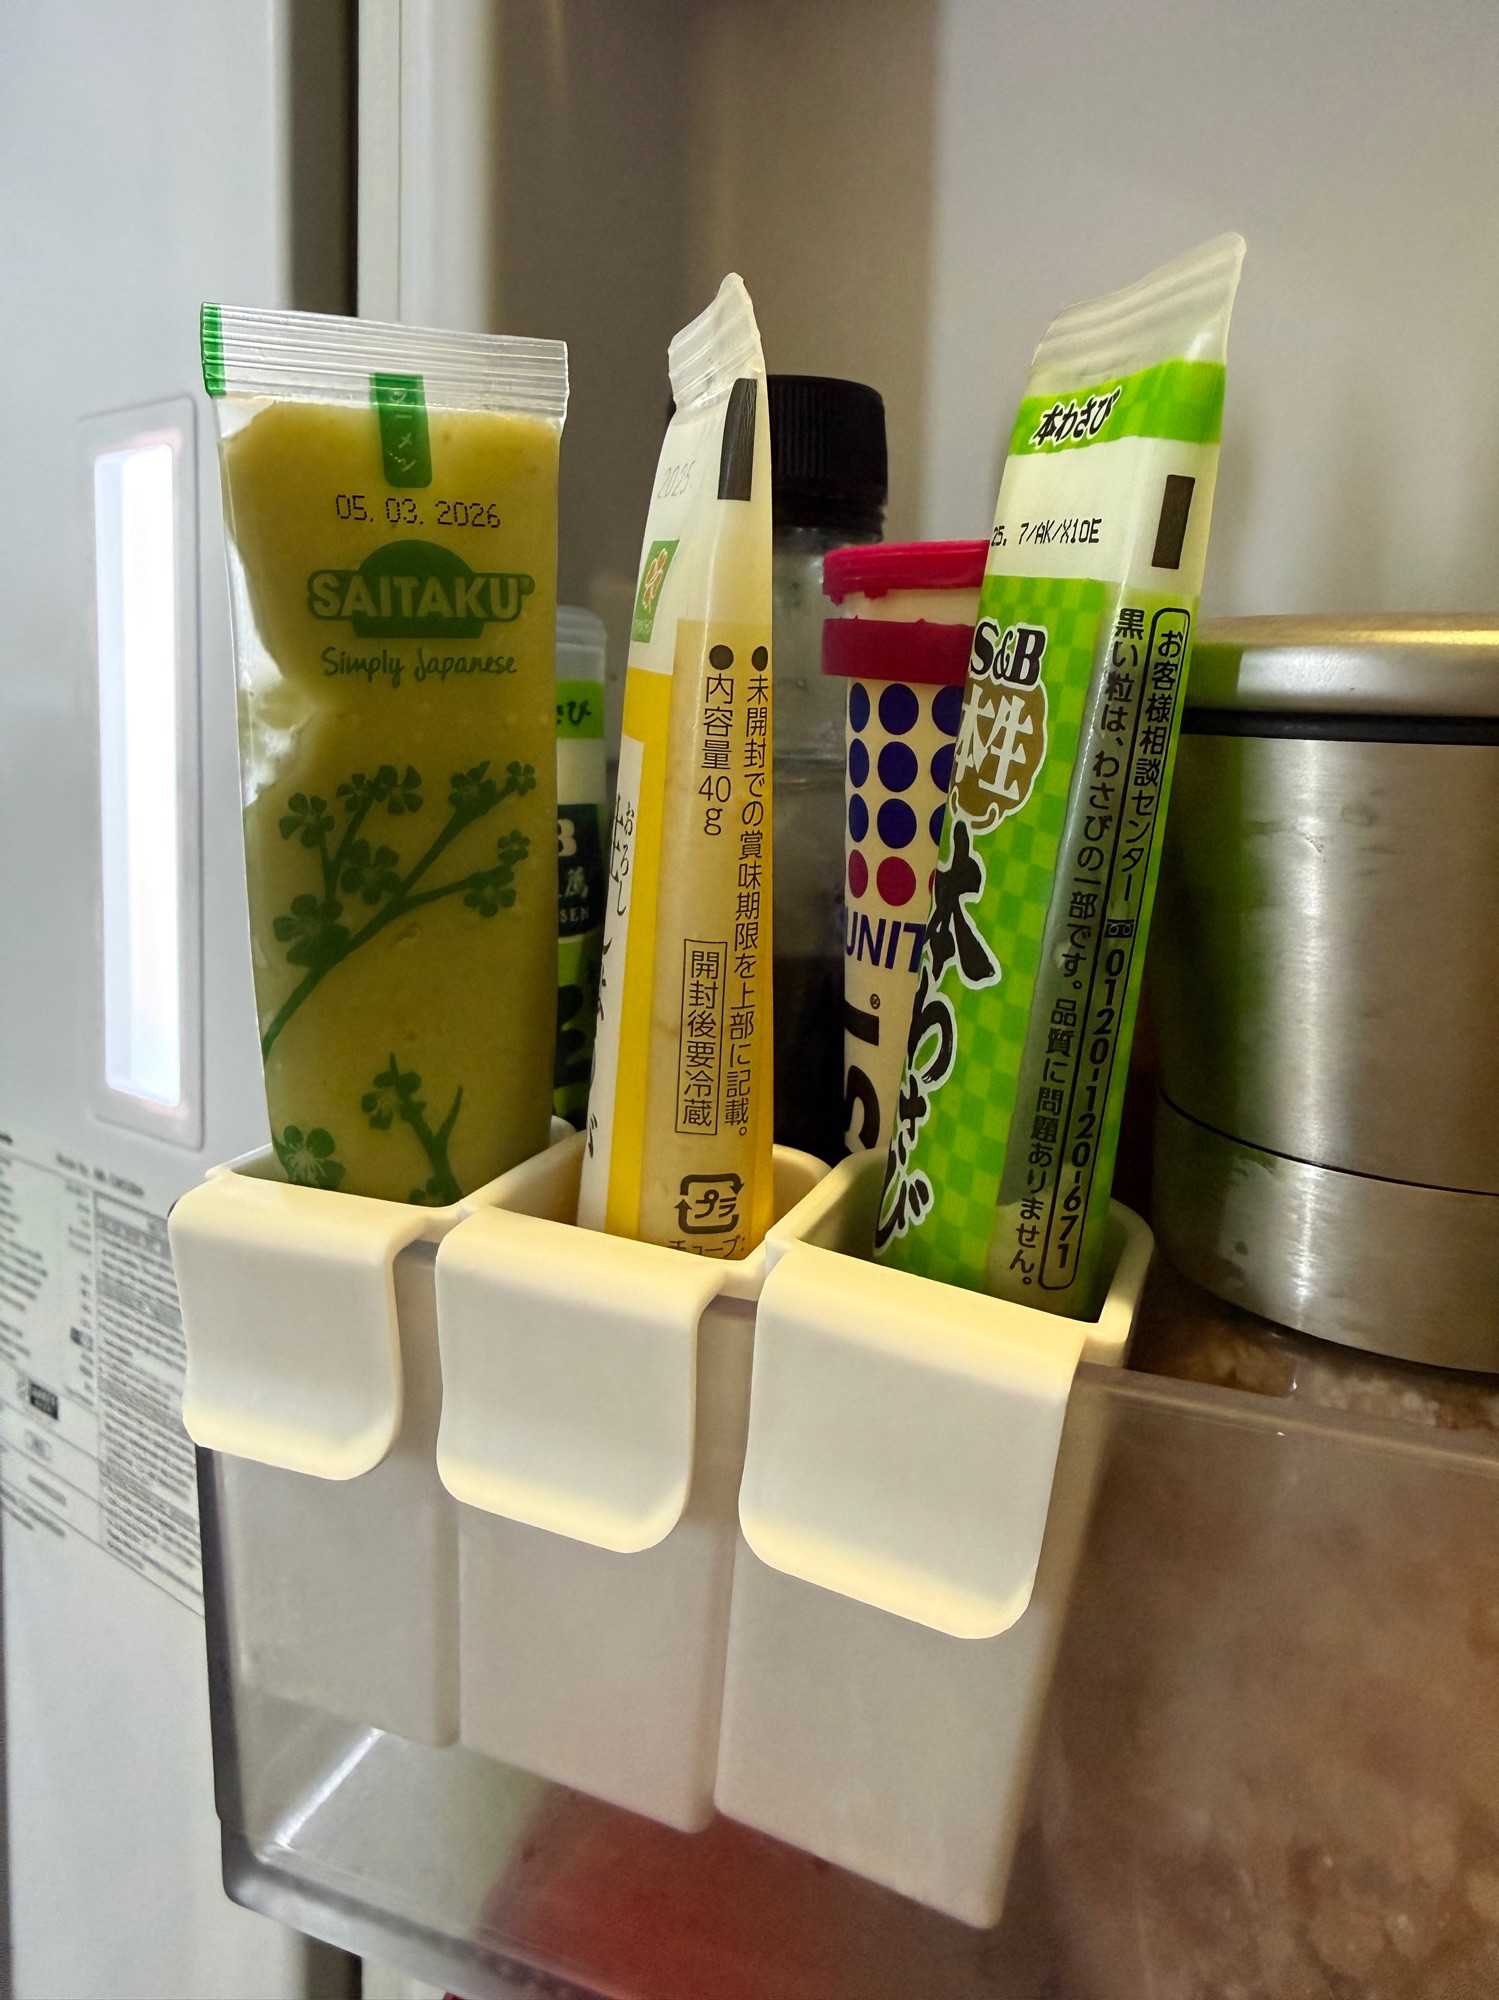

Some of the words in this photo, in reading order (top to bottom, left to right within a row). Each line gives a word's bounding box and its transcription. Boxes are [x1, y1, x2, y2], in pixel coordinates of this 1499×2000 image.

[1030, 387, 1121, 448] 本わさび
[336, 494, 374, 523] 05.
[385, 497, 425, 525] 03.
[435, 501, 501, 528] 2026
[310, 572, 521, 620] SAITAKU
[321, 646, 404, 688] Simply
[415, 647, 518, 681] Japanese
[969, 619, 1047, 687] S&B
[698, 673, 735, 836] 内容量40g
[1121, 630, 1183, 902] お客様相談センター
[683, 950, 720, 1128] 開封後要冷蔵
[1057, 948, 1126, 1270] 0120-120-671
[694, 1189, 737, 1219] プラ
